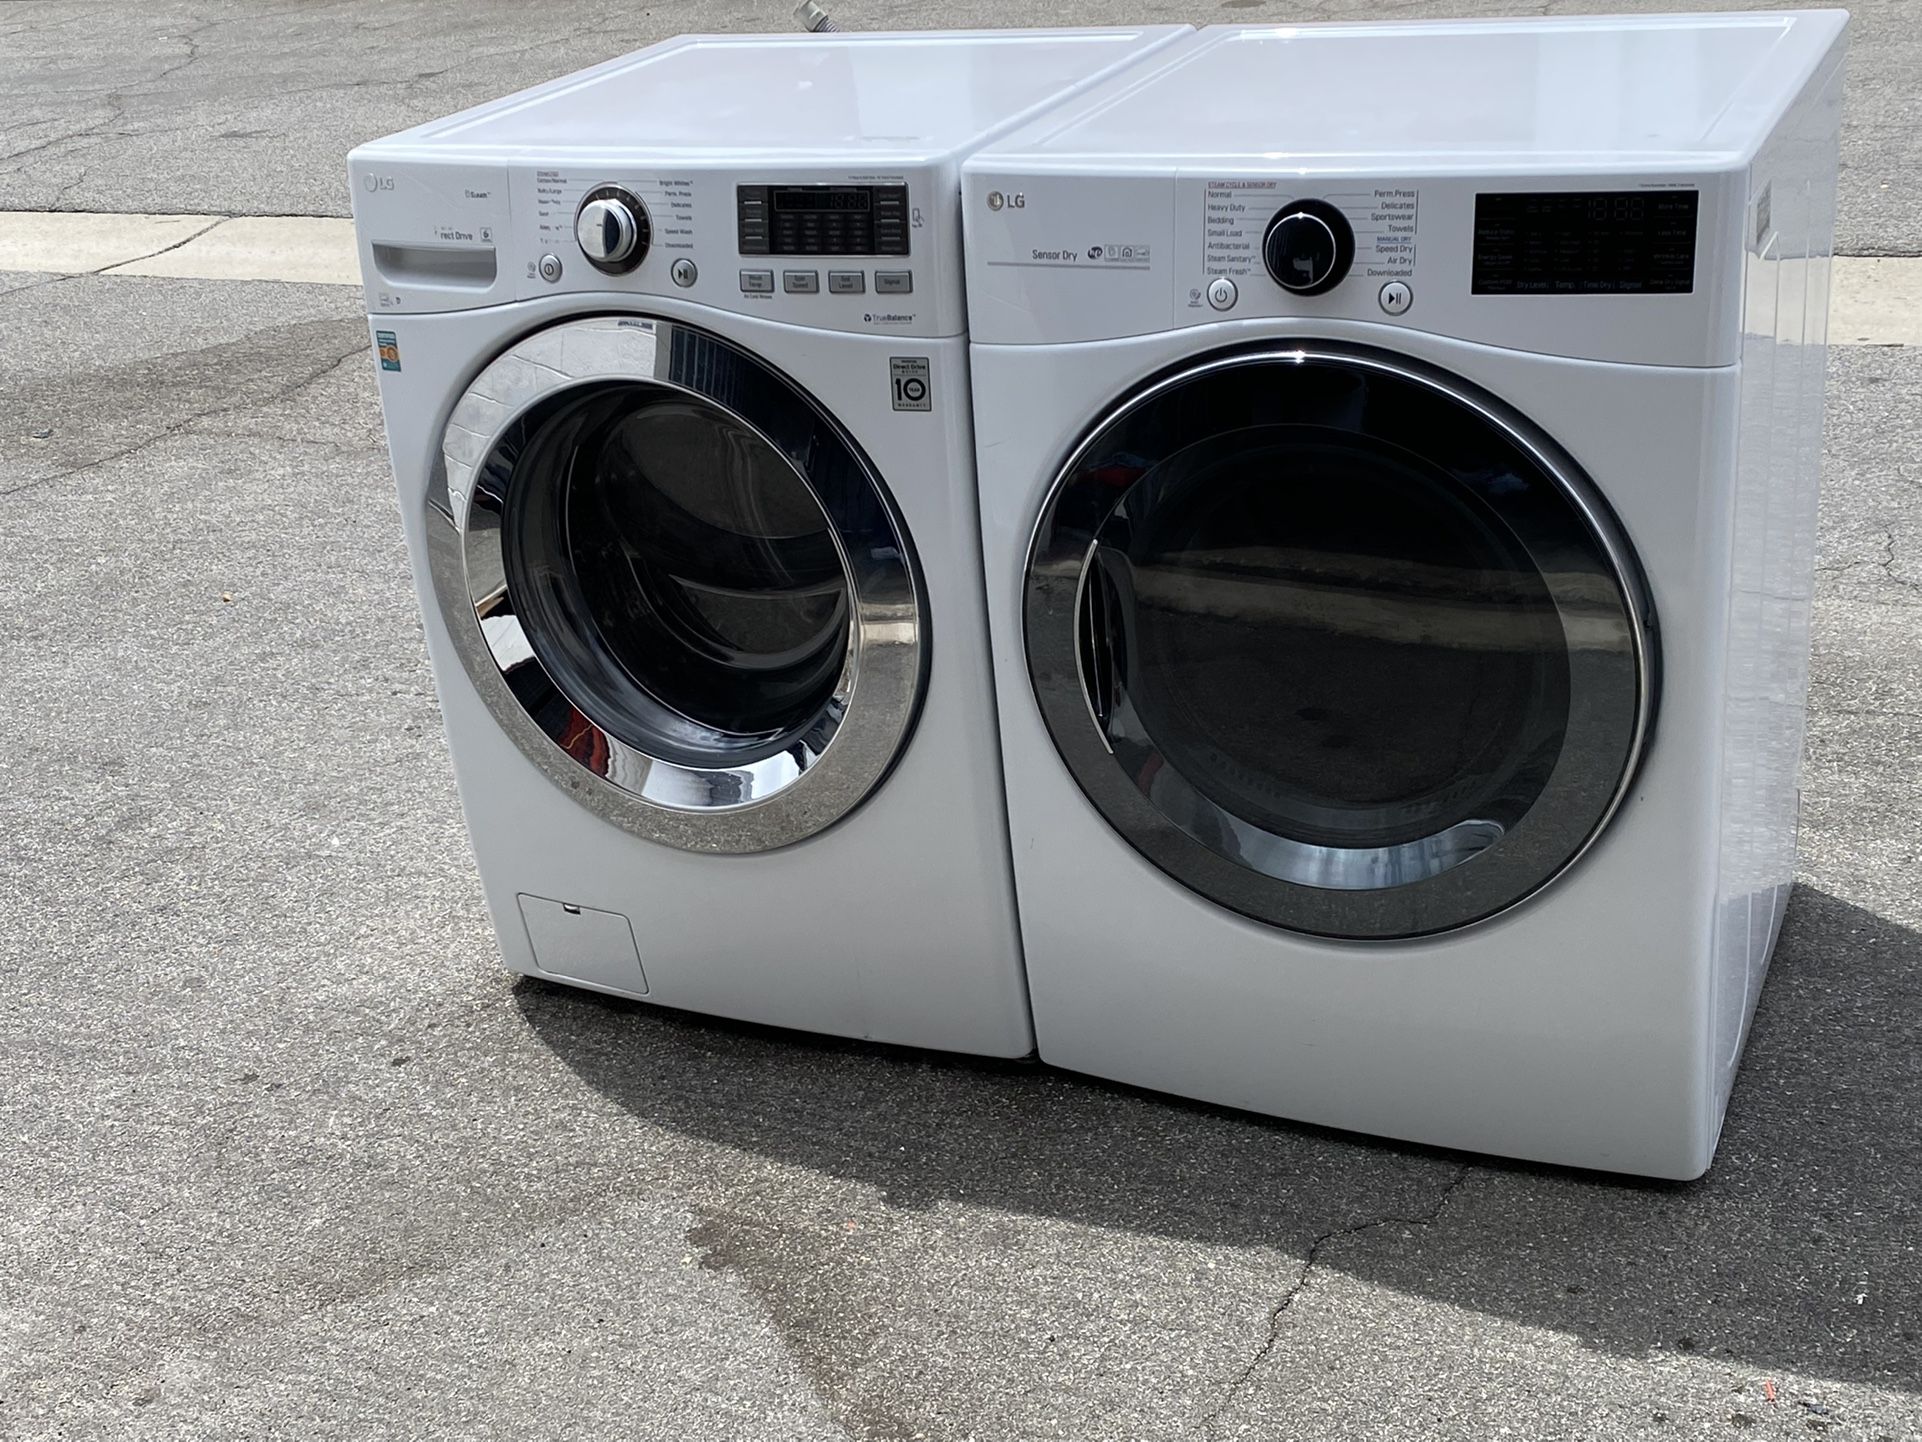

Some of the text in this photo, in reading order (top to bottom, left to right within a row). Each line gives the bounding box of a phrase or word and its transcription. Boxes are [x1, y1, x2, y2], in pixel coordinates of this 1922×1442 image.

[379, 175, 394, 190] LG
[1207, 190, 1232, 198] Normal
[1007, 194, 1026, 209] LG
[1381, 201, 1415, 210] Delicates
[1207, 203, 1246, 213] Heavy Duty
[1207, 216, 1234, 226] Bedding
[1370, 212, 1414, 221] Sportswear
[1207, 228, 1242, 238] Small Load
[1388, 224, 1414, 233] Towels
[1207, 241, 1250, 250] Antibacterial
[1375, 244, 1413, 254] Speed Dry
[1032, 249, 1078, 262] Sensor Dry
[1207, 254, 1225, 262] Steam
[1387, 256, 1413, 266] Air Dry
[1207, 266, 1227, 275] Steam
[1367, 268, 1413, 277] Downloaded
[895, 377, 926, 401] 10
